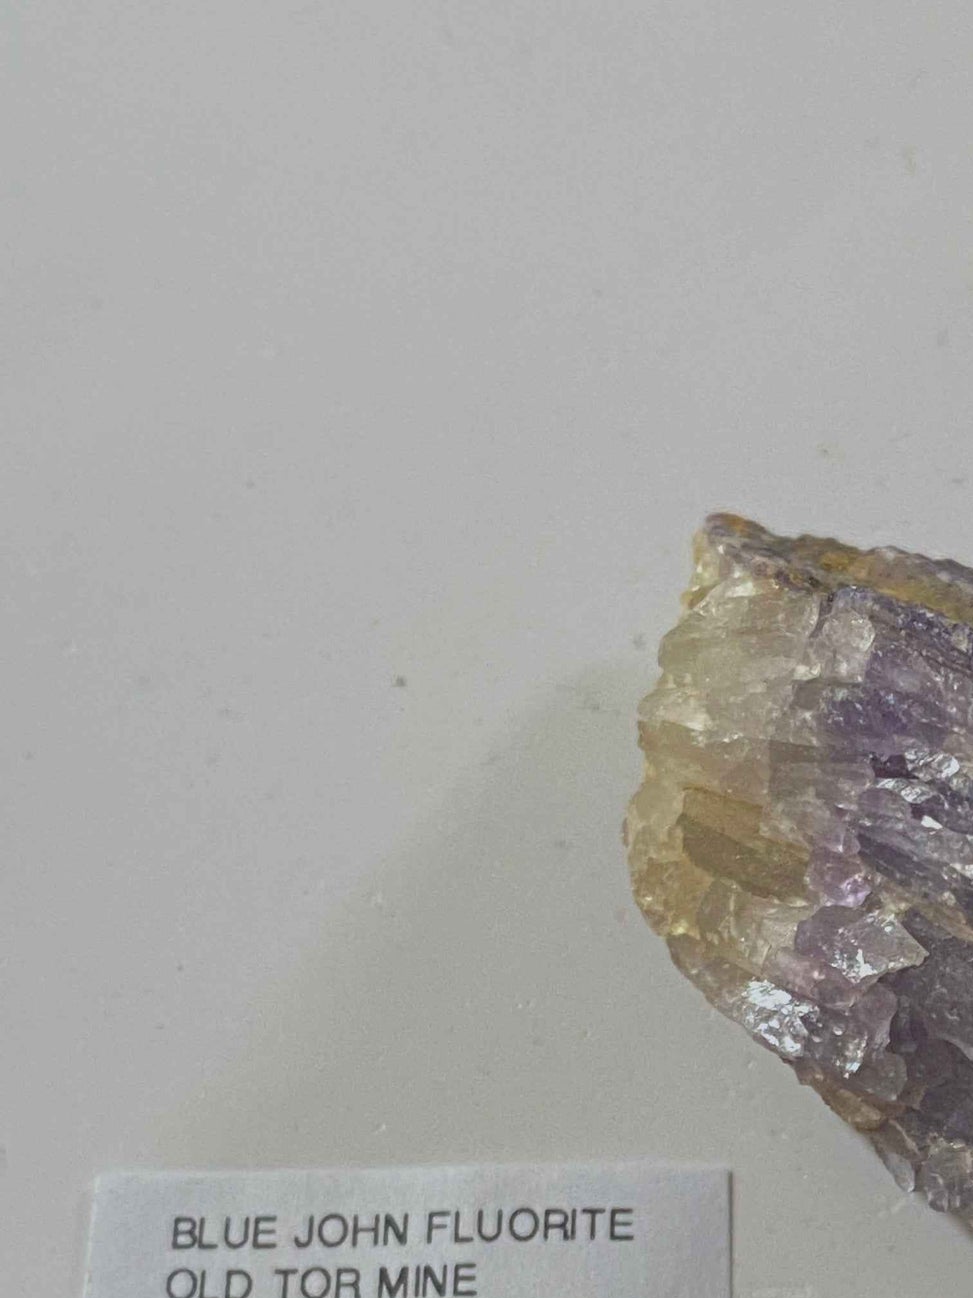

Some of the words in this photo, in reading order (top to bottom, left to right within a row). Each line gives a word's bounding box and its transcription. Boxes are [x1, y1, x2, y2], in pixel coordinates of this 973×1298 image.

[171, 1216, 278, 1251] BLUE
[294, 1213, 410, 1250] JOHN
[427, 1207, 635, 1245] FLUORITE
